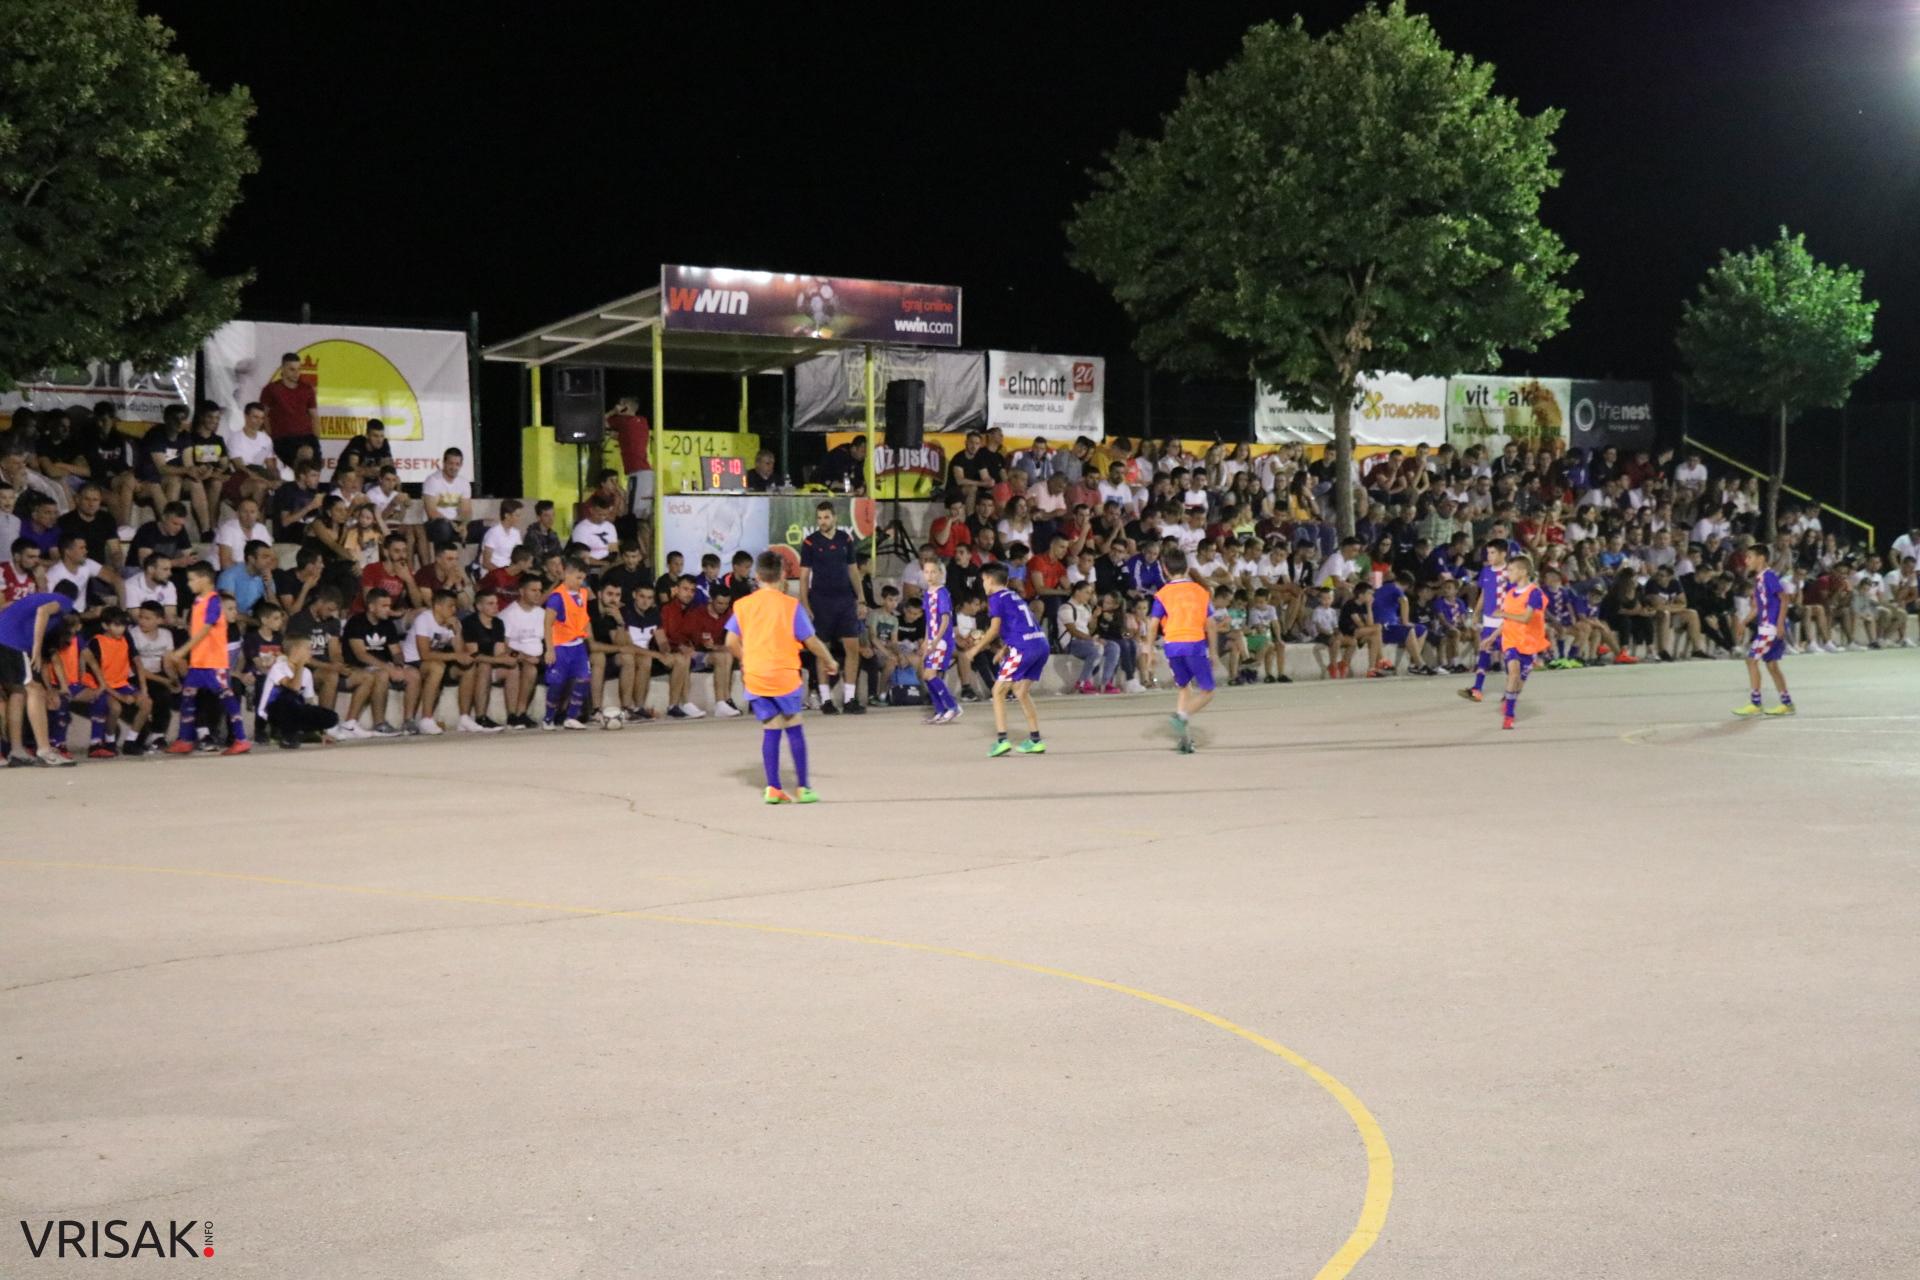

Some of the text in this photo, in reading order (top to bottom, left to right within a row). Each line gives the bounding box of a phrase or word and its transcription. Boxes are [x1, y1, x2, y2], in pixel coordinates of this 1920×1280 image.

[894, 316, 953, 335] wwin.com
[1008, 370, 1066, 397] elmont
[1454, 384, 1489, 405] Kvit
[710, 458, 741, 475] 16:10
[712, 473, 747, 488] 0 1
